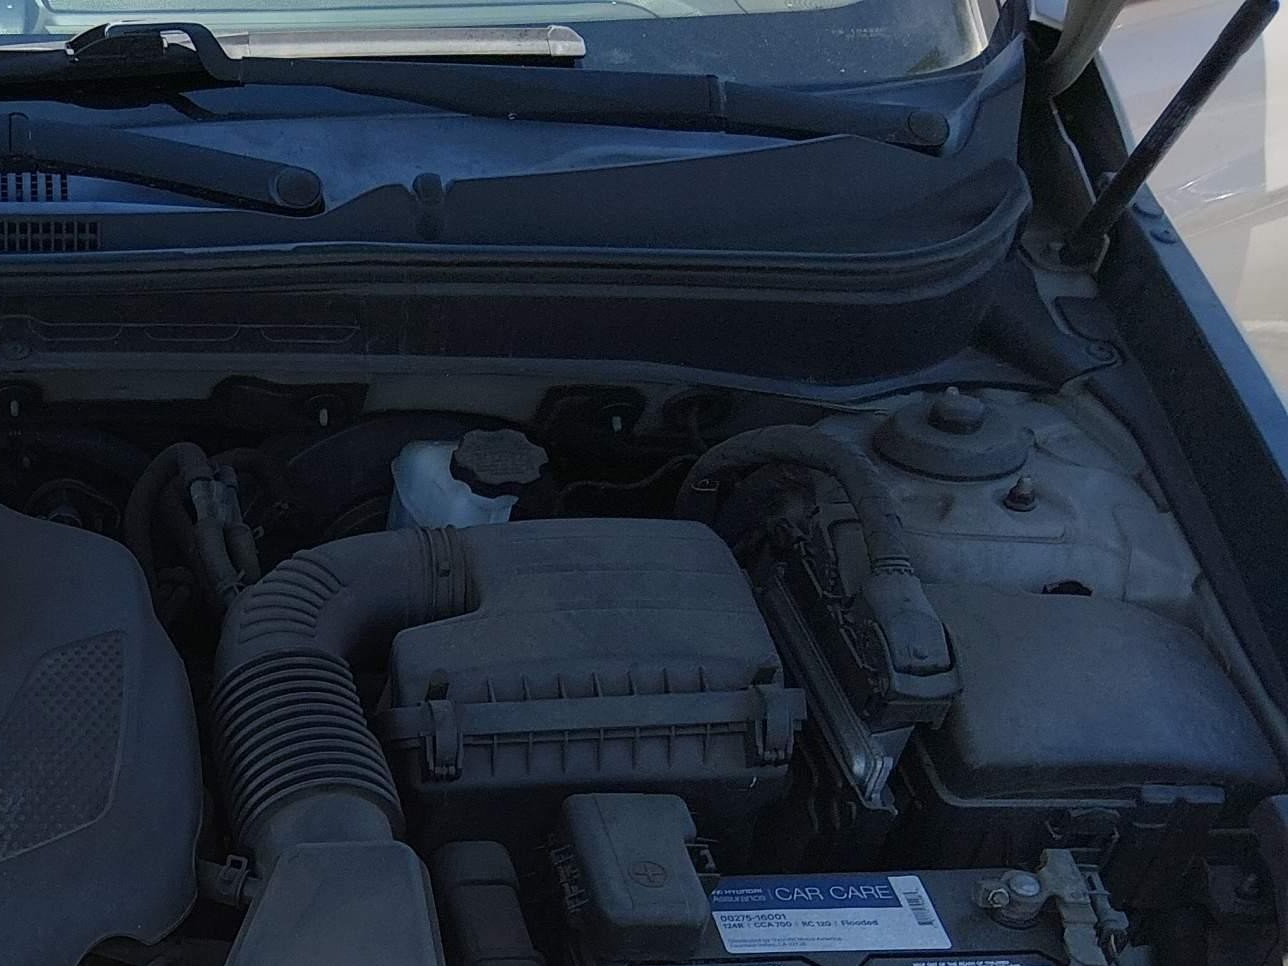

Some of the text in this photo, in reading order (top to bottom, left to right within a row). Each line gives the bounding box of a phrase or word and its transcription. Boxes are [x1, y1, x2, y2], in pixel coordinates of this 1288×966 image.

[724, 887, 763, 896] HYUNDAI
[775, 885, 894, 902] CAR CARE
[720, 912, 787, 923] 00275-16001
